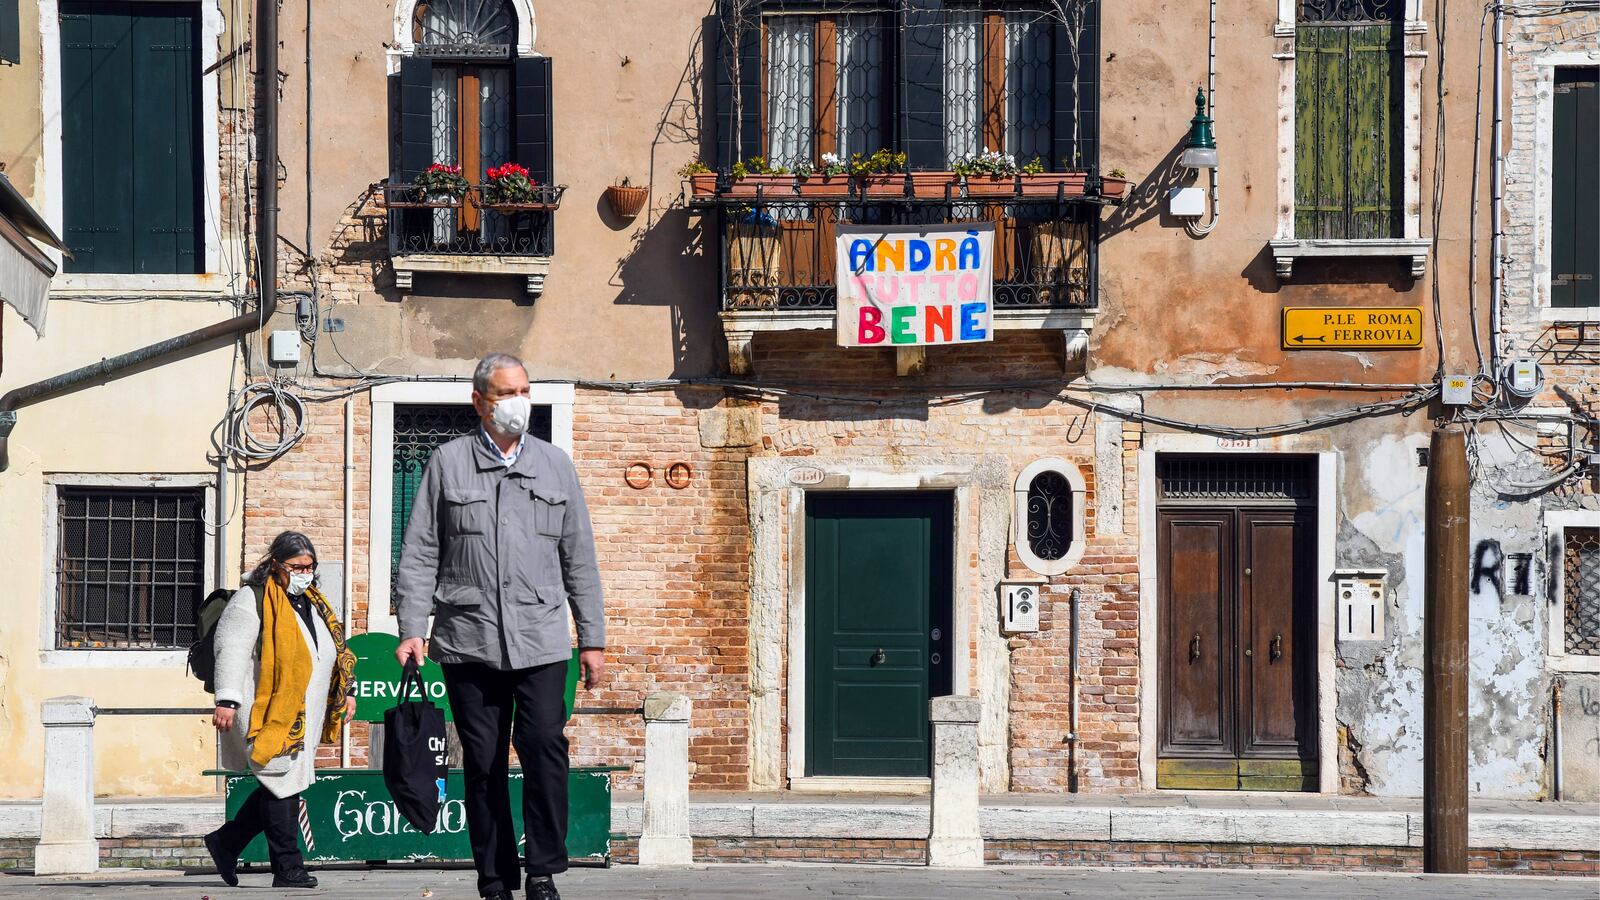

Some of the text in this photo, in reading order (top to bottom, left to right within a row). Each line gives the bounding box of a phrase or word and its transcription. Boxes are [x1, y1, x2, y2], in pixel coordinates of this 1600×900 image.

[849, 230, 980, 272] ANDRÀ
[850, 274, 978, 304] TUTTO
[858, 302, 987, 344] BENE
[1323, 314, 1414, 325] P.LE ROMA
[1333, 329, 1413, 341] FERROVIA
